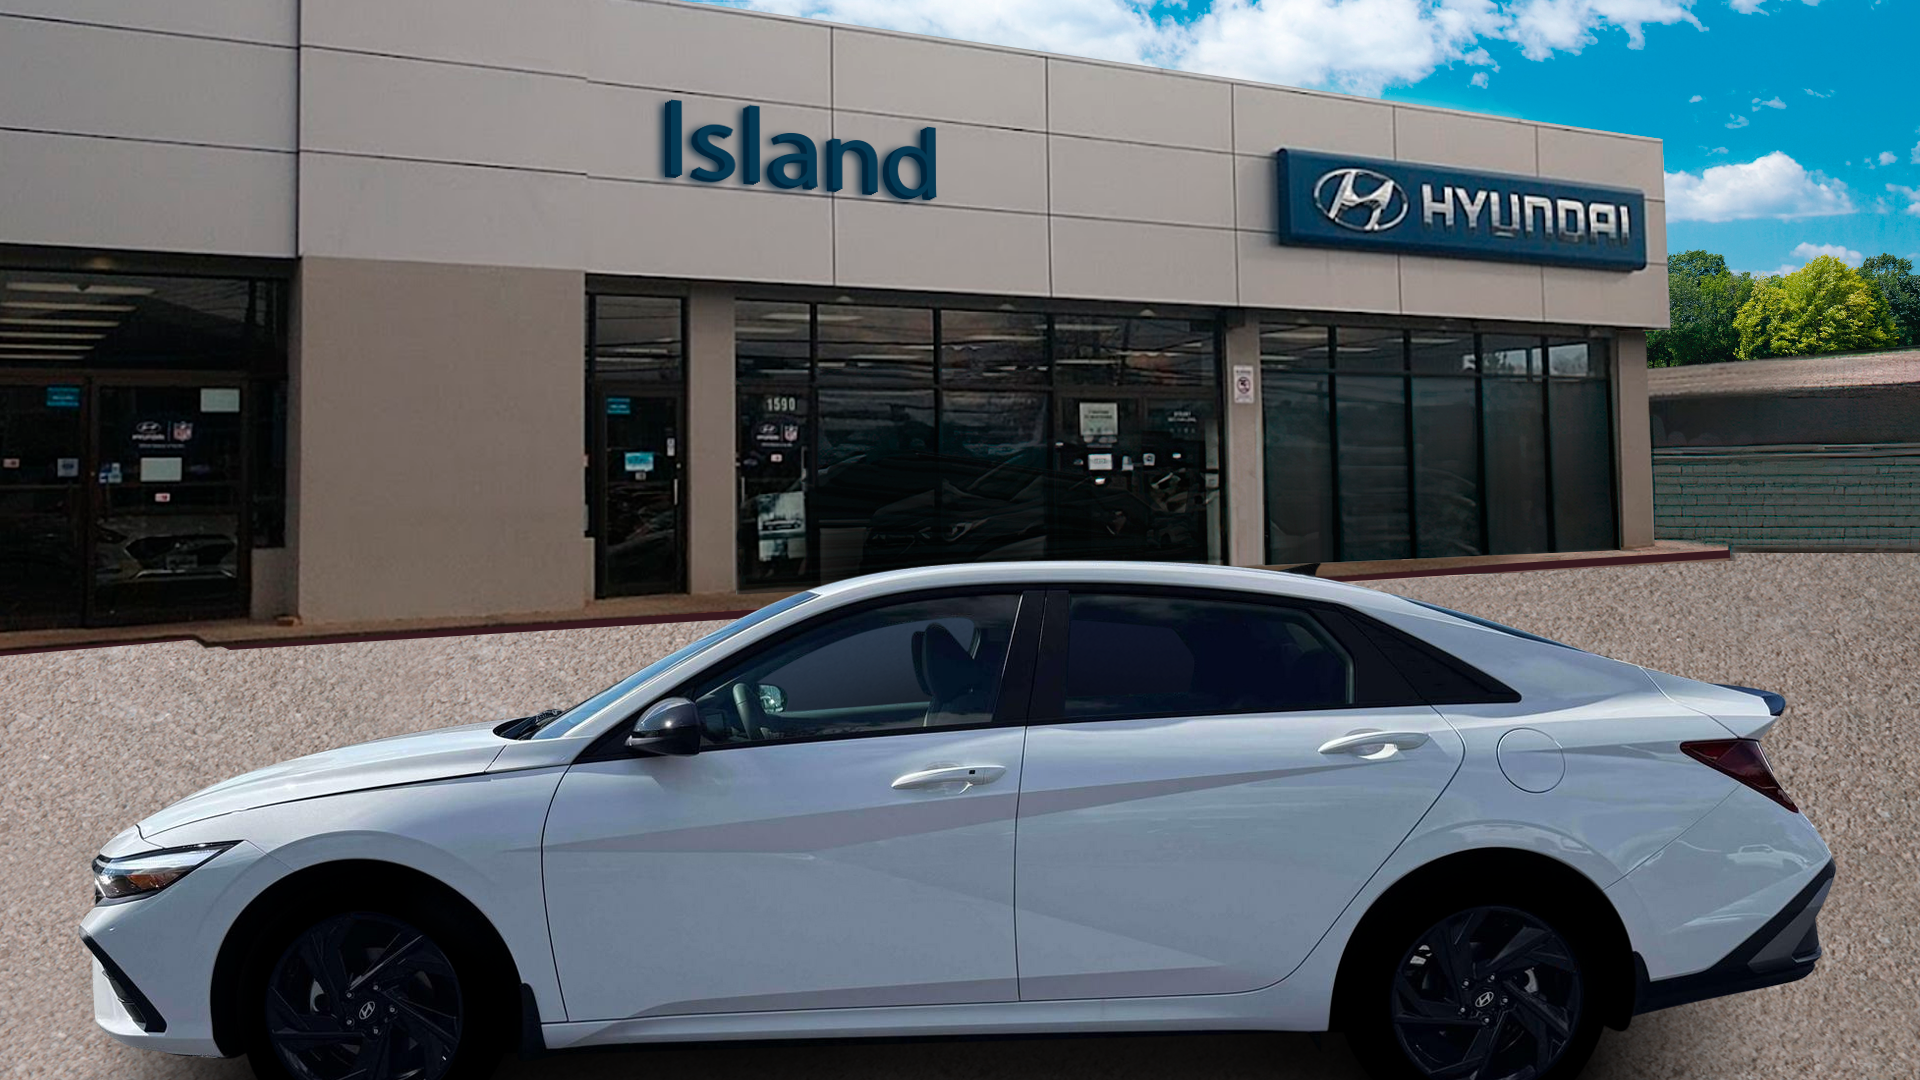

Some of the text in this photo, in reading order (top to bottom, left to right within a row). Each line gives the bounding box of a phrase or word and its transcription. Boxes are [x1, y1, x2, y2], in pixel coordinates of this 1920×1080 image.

[664, 99, 937, 201] Island
[1421, 183, 1631, 245] HYUNDAI
[767, 397, 796, 411] 1590
